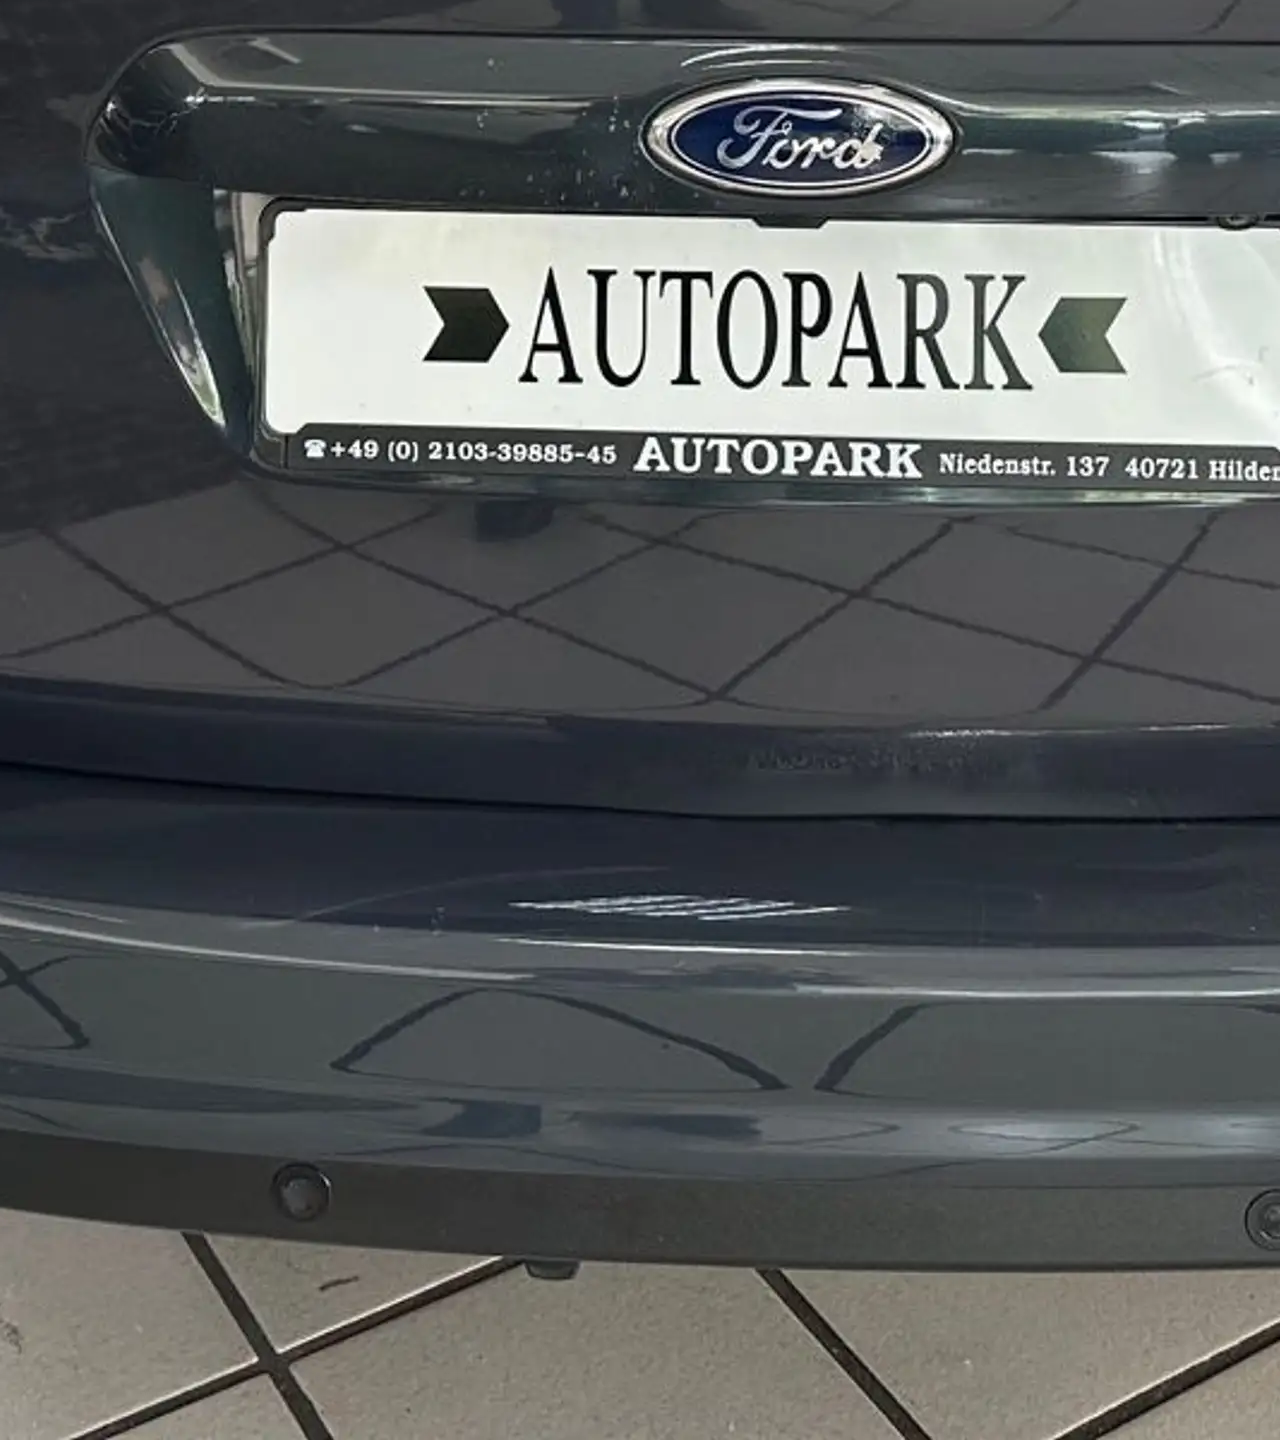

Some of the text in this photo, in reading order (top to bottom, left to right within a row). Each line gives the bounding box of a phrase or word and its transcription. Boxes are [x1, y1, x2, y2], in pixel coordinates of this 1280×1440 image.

[716, 105, 885, 170] Ford
[517, 265, 1034, 391] AUTOPARK
[387, 439, 419, 462] (0)
[428, 440, 618, 464] 2103-39885-45
[632, 435, 923, 479] AUTOPARK
[939, 452, 1056, 477] Niedenstr.
[1065, 455, 1111, 478] 137
[1124, 456, 1199, 480] 40721
